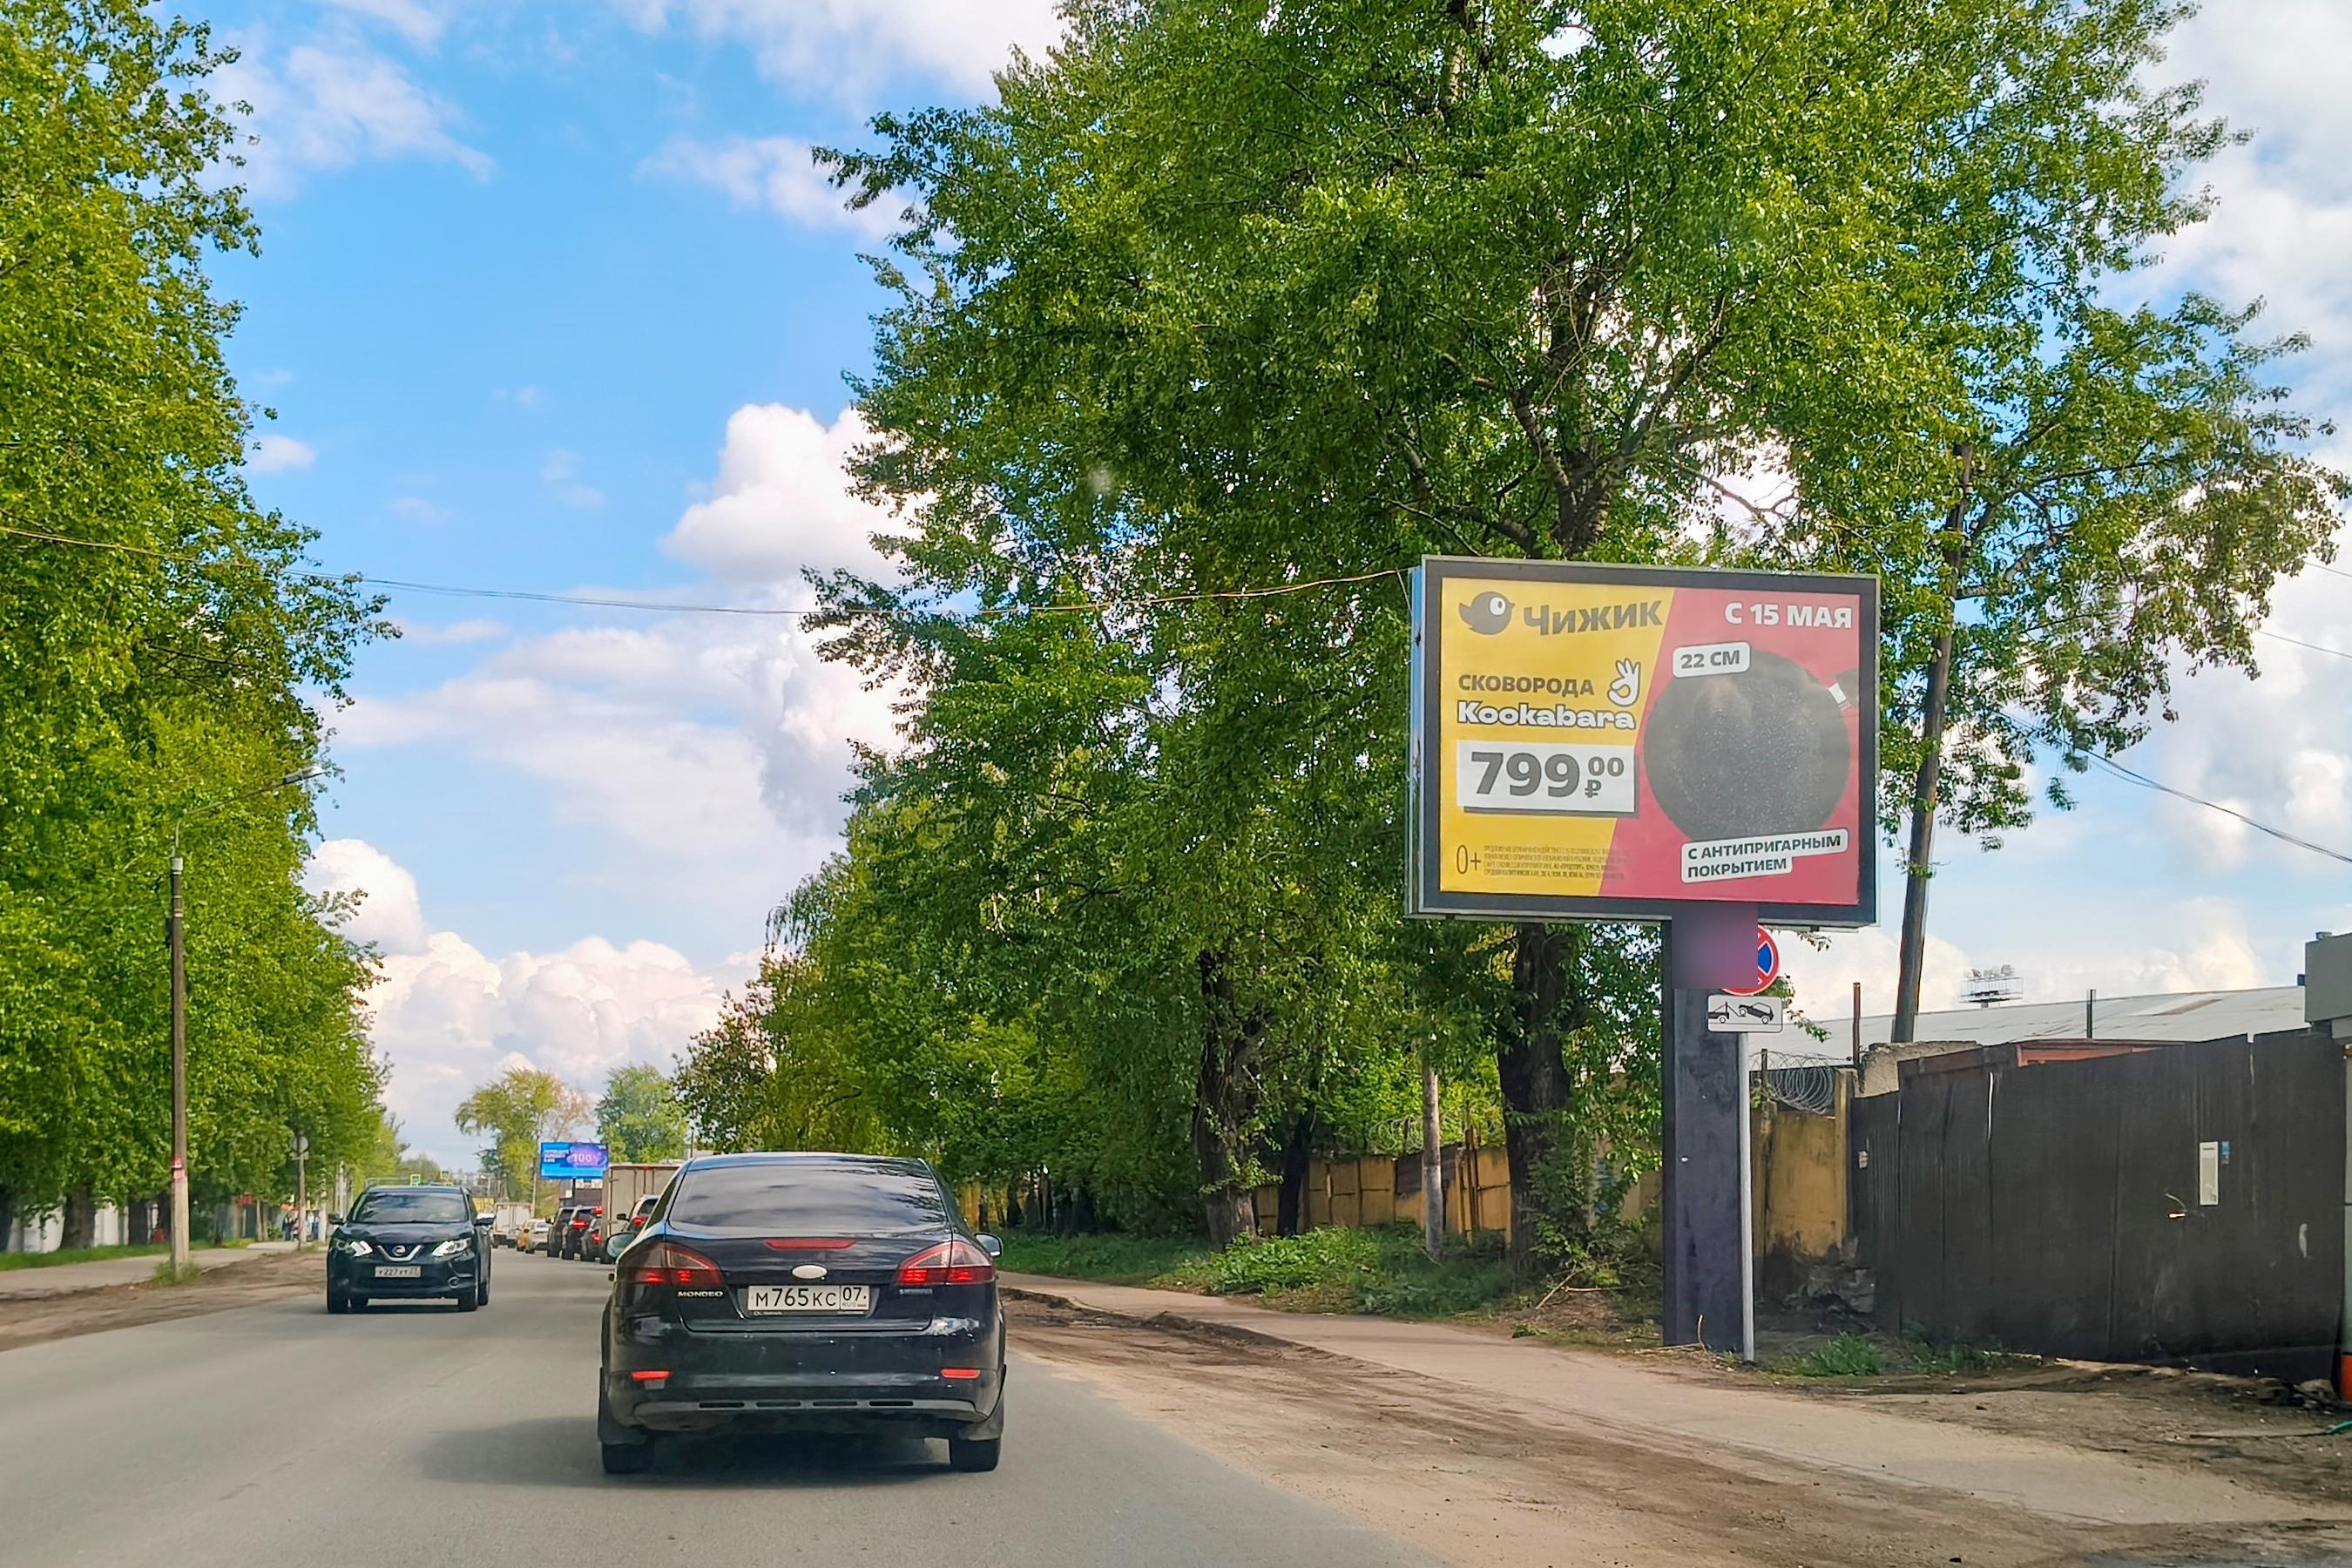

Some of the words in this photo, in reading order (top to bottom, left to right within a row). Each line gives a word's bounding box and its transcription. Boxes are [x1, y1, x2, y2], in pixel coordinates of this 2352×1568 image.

[1725, 602, 1742, 624] С
[1750, 603, 1779, 625] 15
[1787, 605, 1852, 628] МАЯ
[1680, 653, 1705, 669] 22
[1710, 650, 1740, 666] СМ
[1458, 674, 1594, 697] СКОВОРОДА
[1457, 700, 1636, 730] Kookabara
[1471, 752, 1580, 797] 799
[1588, 756, 1625, 777] 00
[1456, 844, 1481, 875] 0+
[1688, 848, 1698, 860] С
[1701, 835, 1841, 859] АНТИПРИГАРНЫМ
[1688, 858, 1787, 878] ПОКРЫТИЕМ
